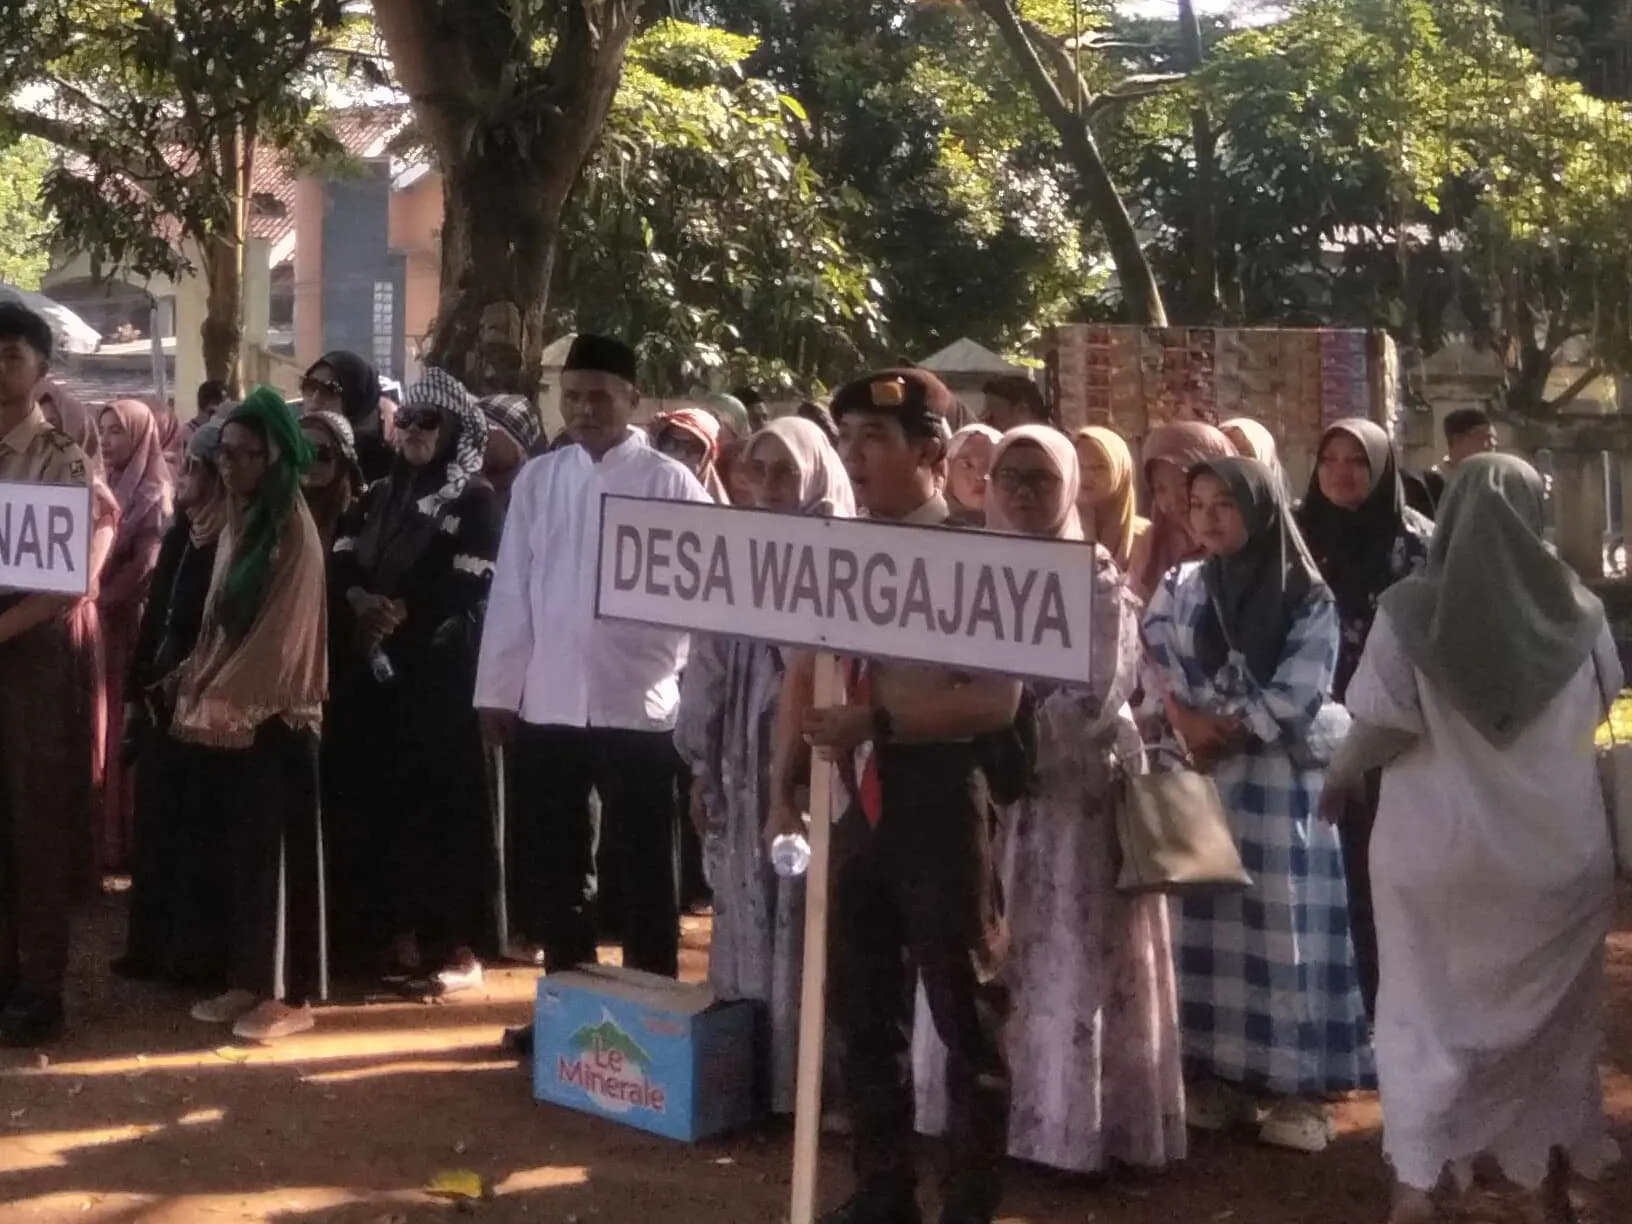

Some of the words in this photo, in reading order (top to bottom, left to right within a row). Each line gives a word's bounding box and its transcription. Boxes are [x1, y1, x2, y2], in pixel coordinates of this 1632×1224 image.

[614, 524, 734, 607] DESA
[749, 538, 1072, 649] WARGAJAYA
[558, 1053, 666, 1112] Minerale
[595, 1034, 623, 1073] Le
